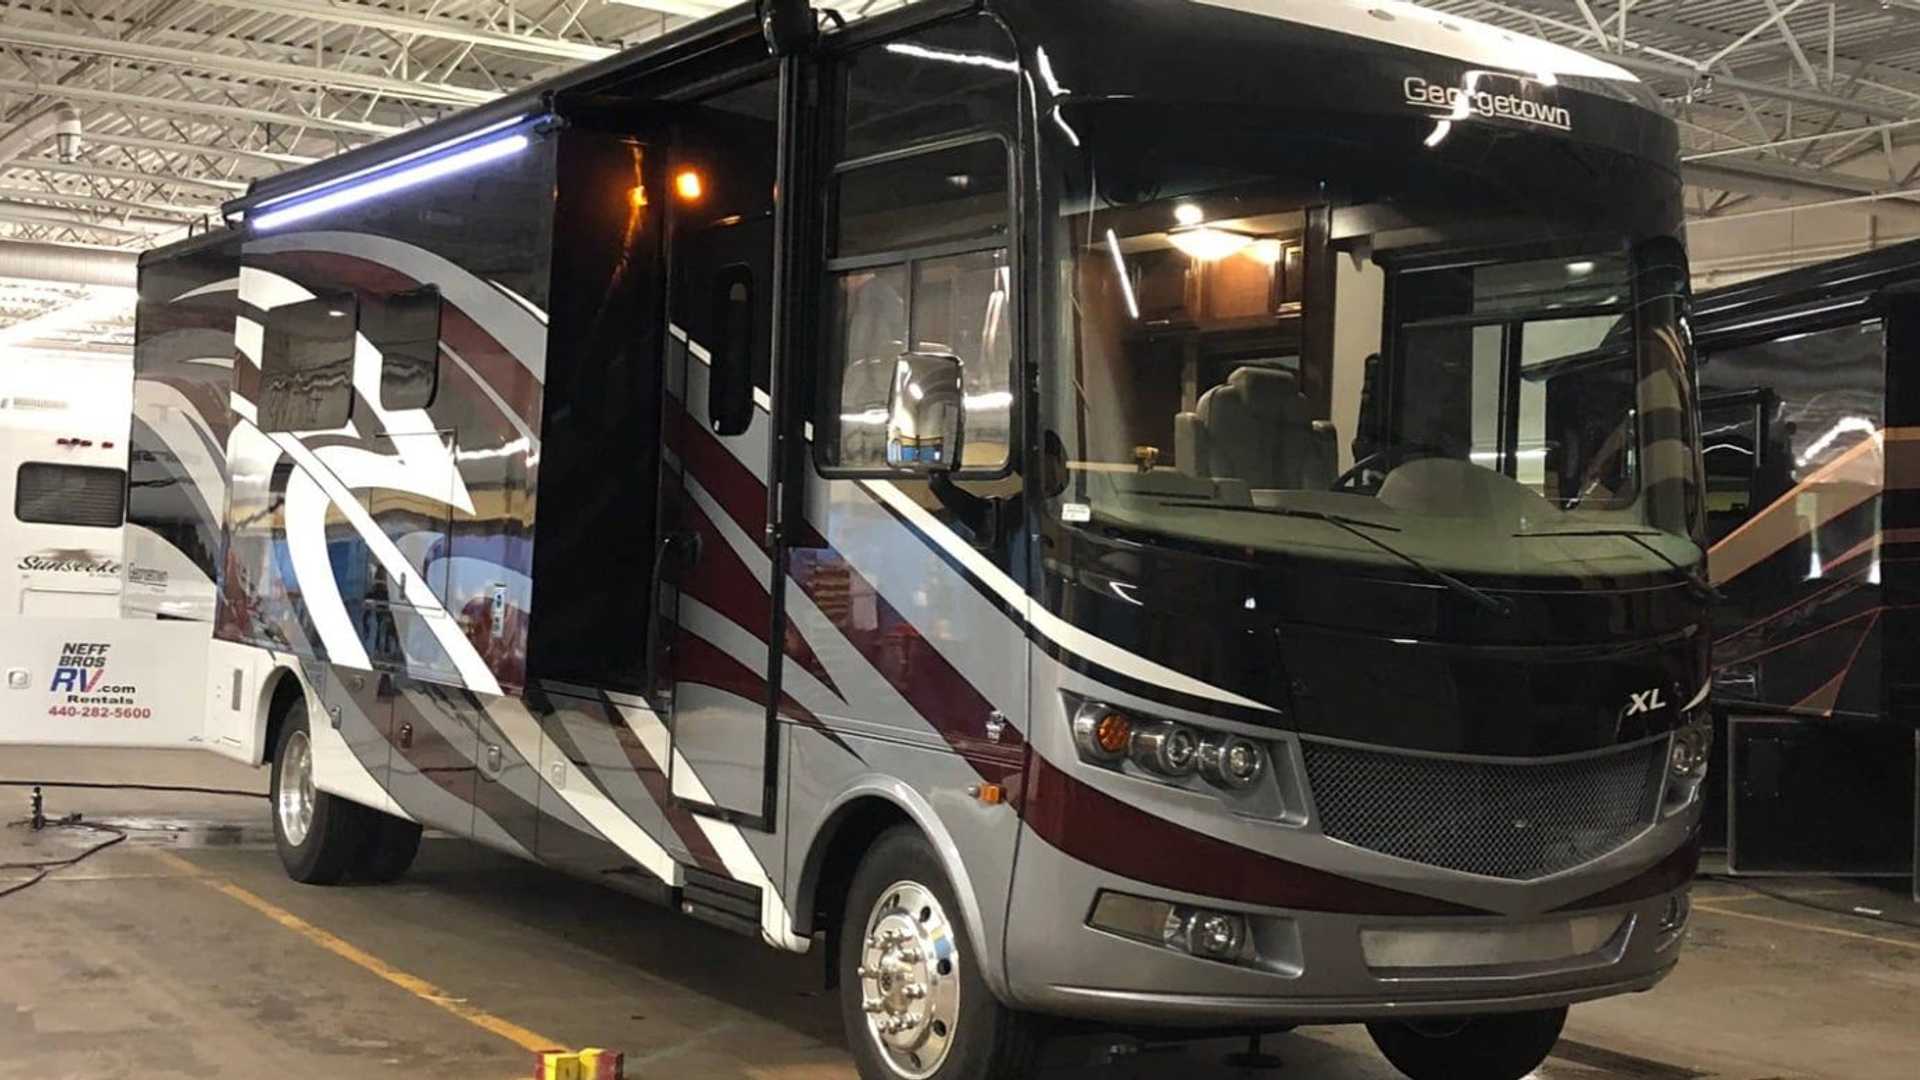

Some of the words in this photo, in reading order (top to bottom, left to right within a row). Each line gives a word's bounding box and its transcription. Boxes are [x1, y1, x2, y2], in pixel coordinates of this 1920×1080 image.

[1404, 77, 1572, 127] Geogetown
[18, 555, 122, 573] Sunseeke
[62, 643, 110, 655] NEFF
[58, 656, 106, 667] BROS
[67, 696, 134, 704] Rentals
[1626, 689, 1666, 716] XL
[48, 706, 151, 718] 440-282-5600
